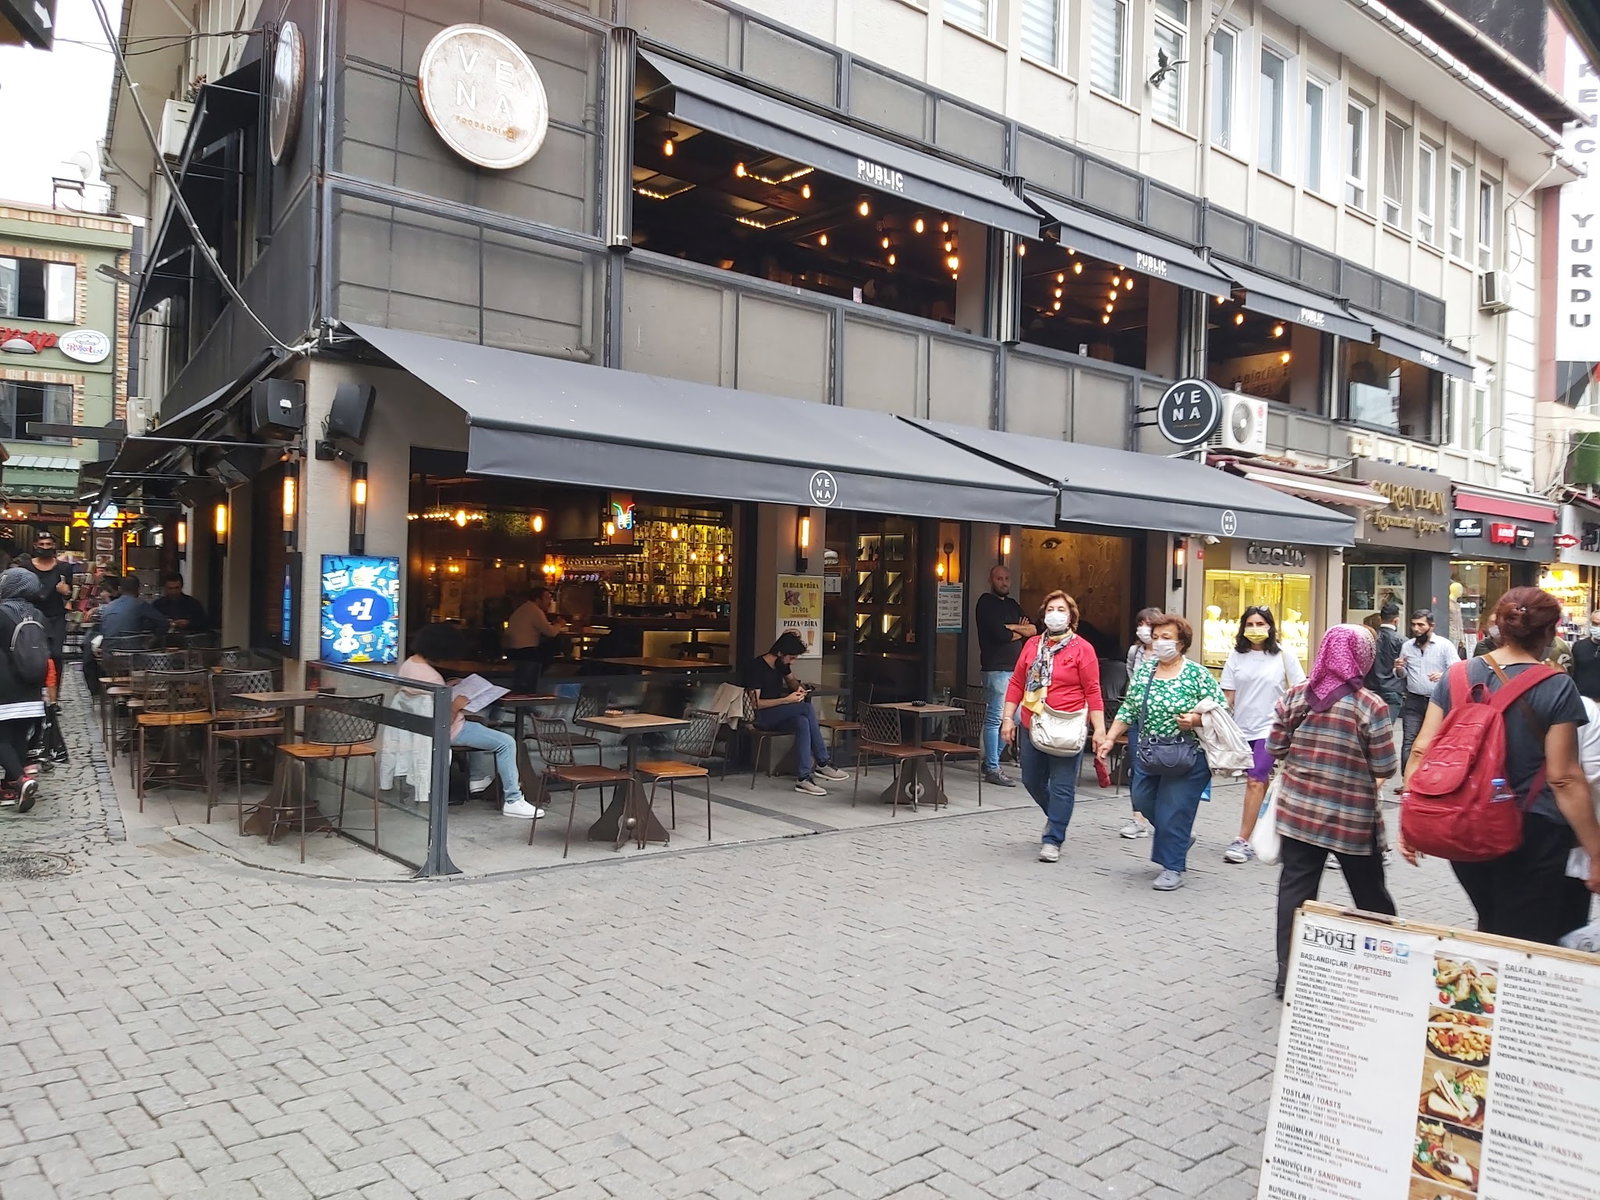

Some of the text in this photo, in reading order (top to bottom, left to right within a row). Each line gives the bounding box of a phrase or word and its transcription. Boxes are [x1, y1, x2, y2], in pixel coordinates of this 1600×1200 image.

[857, 159, 903, 188] PUBLIC
[1136, 252, 1167, 273] PUBLIC
[1569, 213, 1594, 328] YURDU
[1173, 390, 1202, 405] VE
[1172, 406, 1201, 421] NA
[816, 478, 830, 487] VE
[816, 490, 831, 499] NA
[1247, 541, 1306, 567] ÖZGÜN
[347, 598, 374, 621] +1
[1505, 963, 1547, 978] SALATALAR
[1495, 1071, 1525, 1085] NOODLE
[1533, 1080, 1564, 1095] NOODLE
[1283, 1087, 1311, 1101] TOSTLAR
[1317, 1097, 1342, 1109] TOASTS
[1277, 1121, 1314, 1138] DÜRÜMLER
[1319, 1133, 1340, 1146] ROLLS
[1490, 1128, 1544, 1149] MAKARNALAR
[1551, 1145, 1583, 1161] PASTAS
[1273, 1156, 1313, 1174] SANDVİÇLER
[1318, 1170, 1362, 1189] SANDWICHES
[1269, 1185, 1307, 1200] BURGERLER
